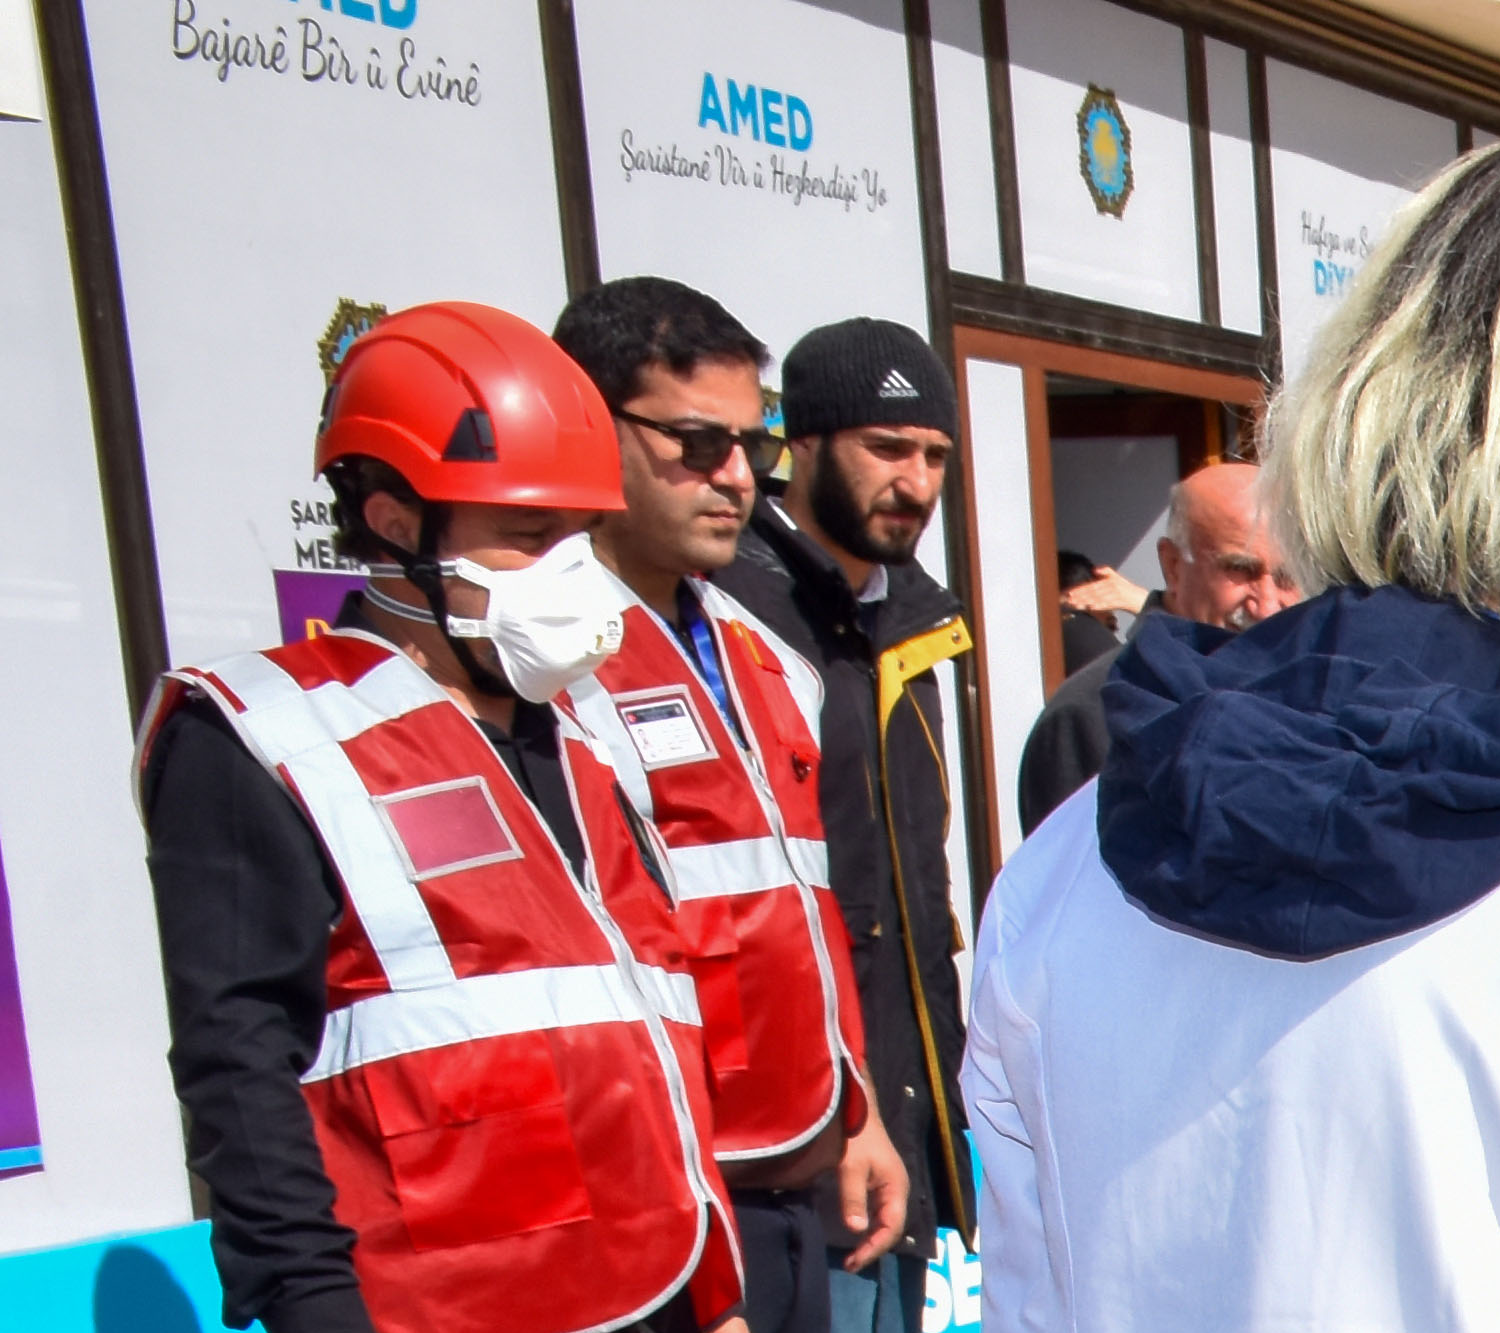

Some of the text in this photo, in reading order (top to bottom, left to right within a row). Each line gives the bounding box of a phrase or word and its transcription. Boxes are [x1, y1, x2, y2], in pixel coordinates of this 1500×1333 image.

[172, 0, 289, 83] Bajarê
[298, 18, 357, 82] Bîr
[366, 47, 387, 91] û
[397, 37, 482, 107] Evînê
[698, 71, 814, 152] AMED
[861, 168, 887, 212] Yo
